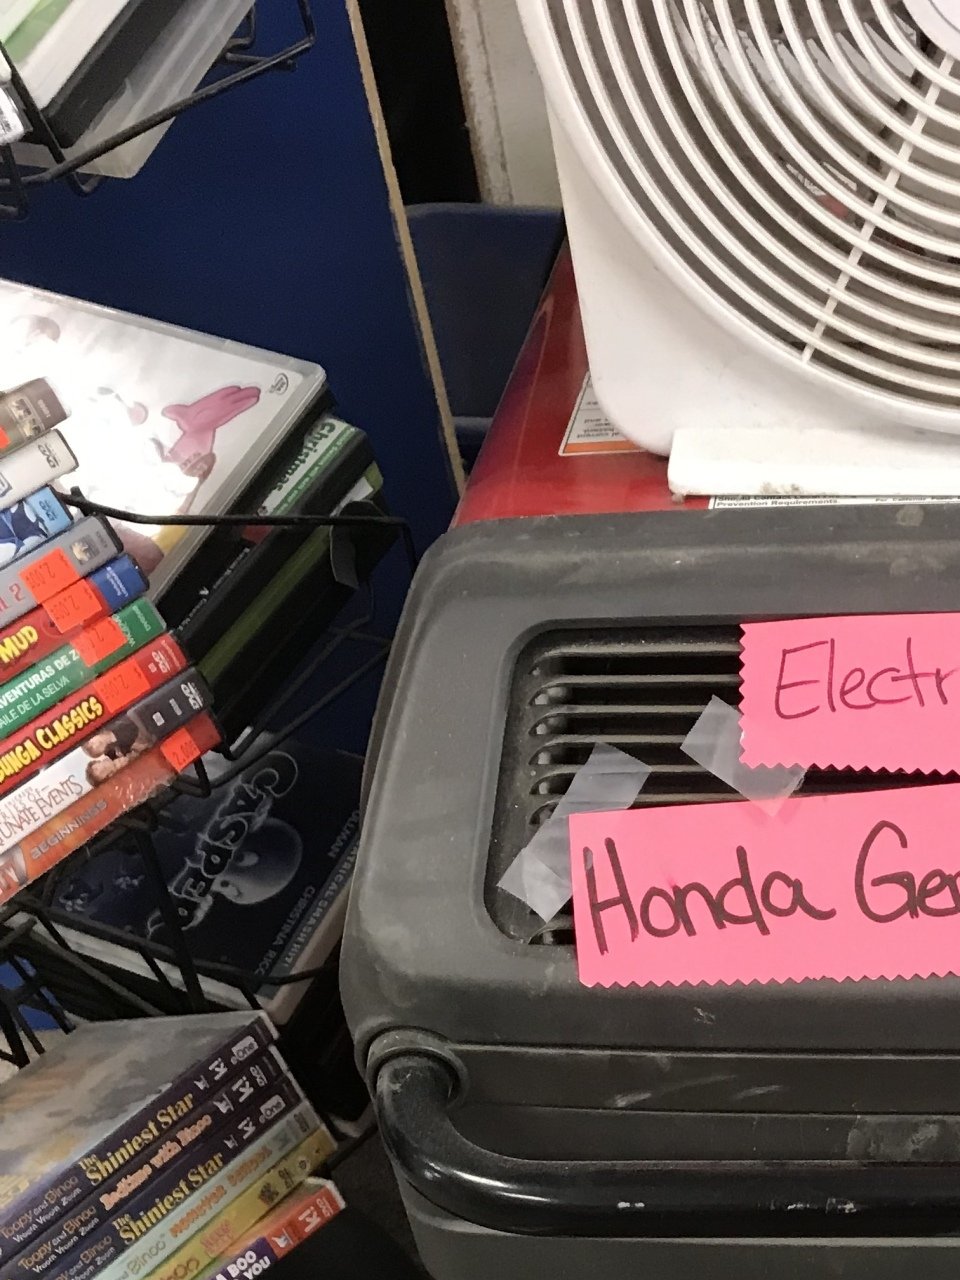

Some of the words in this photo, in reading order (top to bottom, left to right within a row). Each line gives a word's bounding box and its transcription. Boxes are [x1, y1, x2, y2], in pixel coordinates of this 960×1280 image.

[0, 625, 39, 664] MUD
[52, 655, 72, 671] DE
[18, 700, 33, 716] DE
[31, 692, 44, 707] LA
[42, 675, 71, 701] SELVA
[35, 696, 104, 751] CLASSICS
[38, 774, 84, 819] EVENTS
[30, 799, 108, 860] BEGINNINGS
[579, 837, 837, 955] Honda
[85, 1119, 160, 1187] Shiniest
[156, 1093, 194, 1130] Star
[78, 1153, 98, 1171] The
[118, 1178, 191, 1246] Shiniest
[187, 1152, 224, 1189] Star
[112, 1213, 131, 1231] The
[127, 1239, 167, 1275] Binoo
[226, 1250, 257, 1278] BOO
[243, 1256, 271, 1280] YOU
